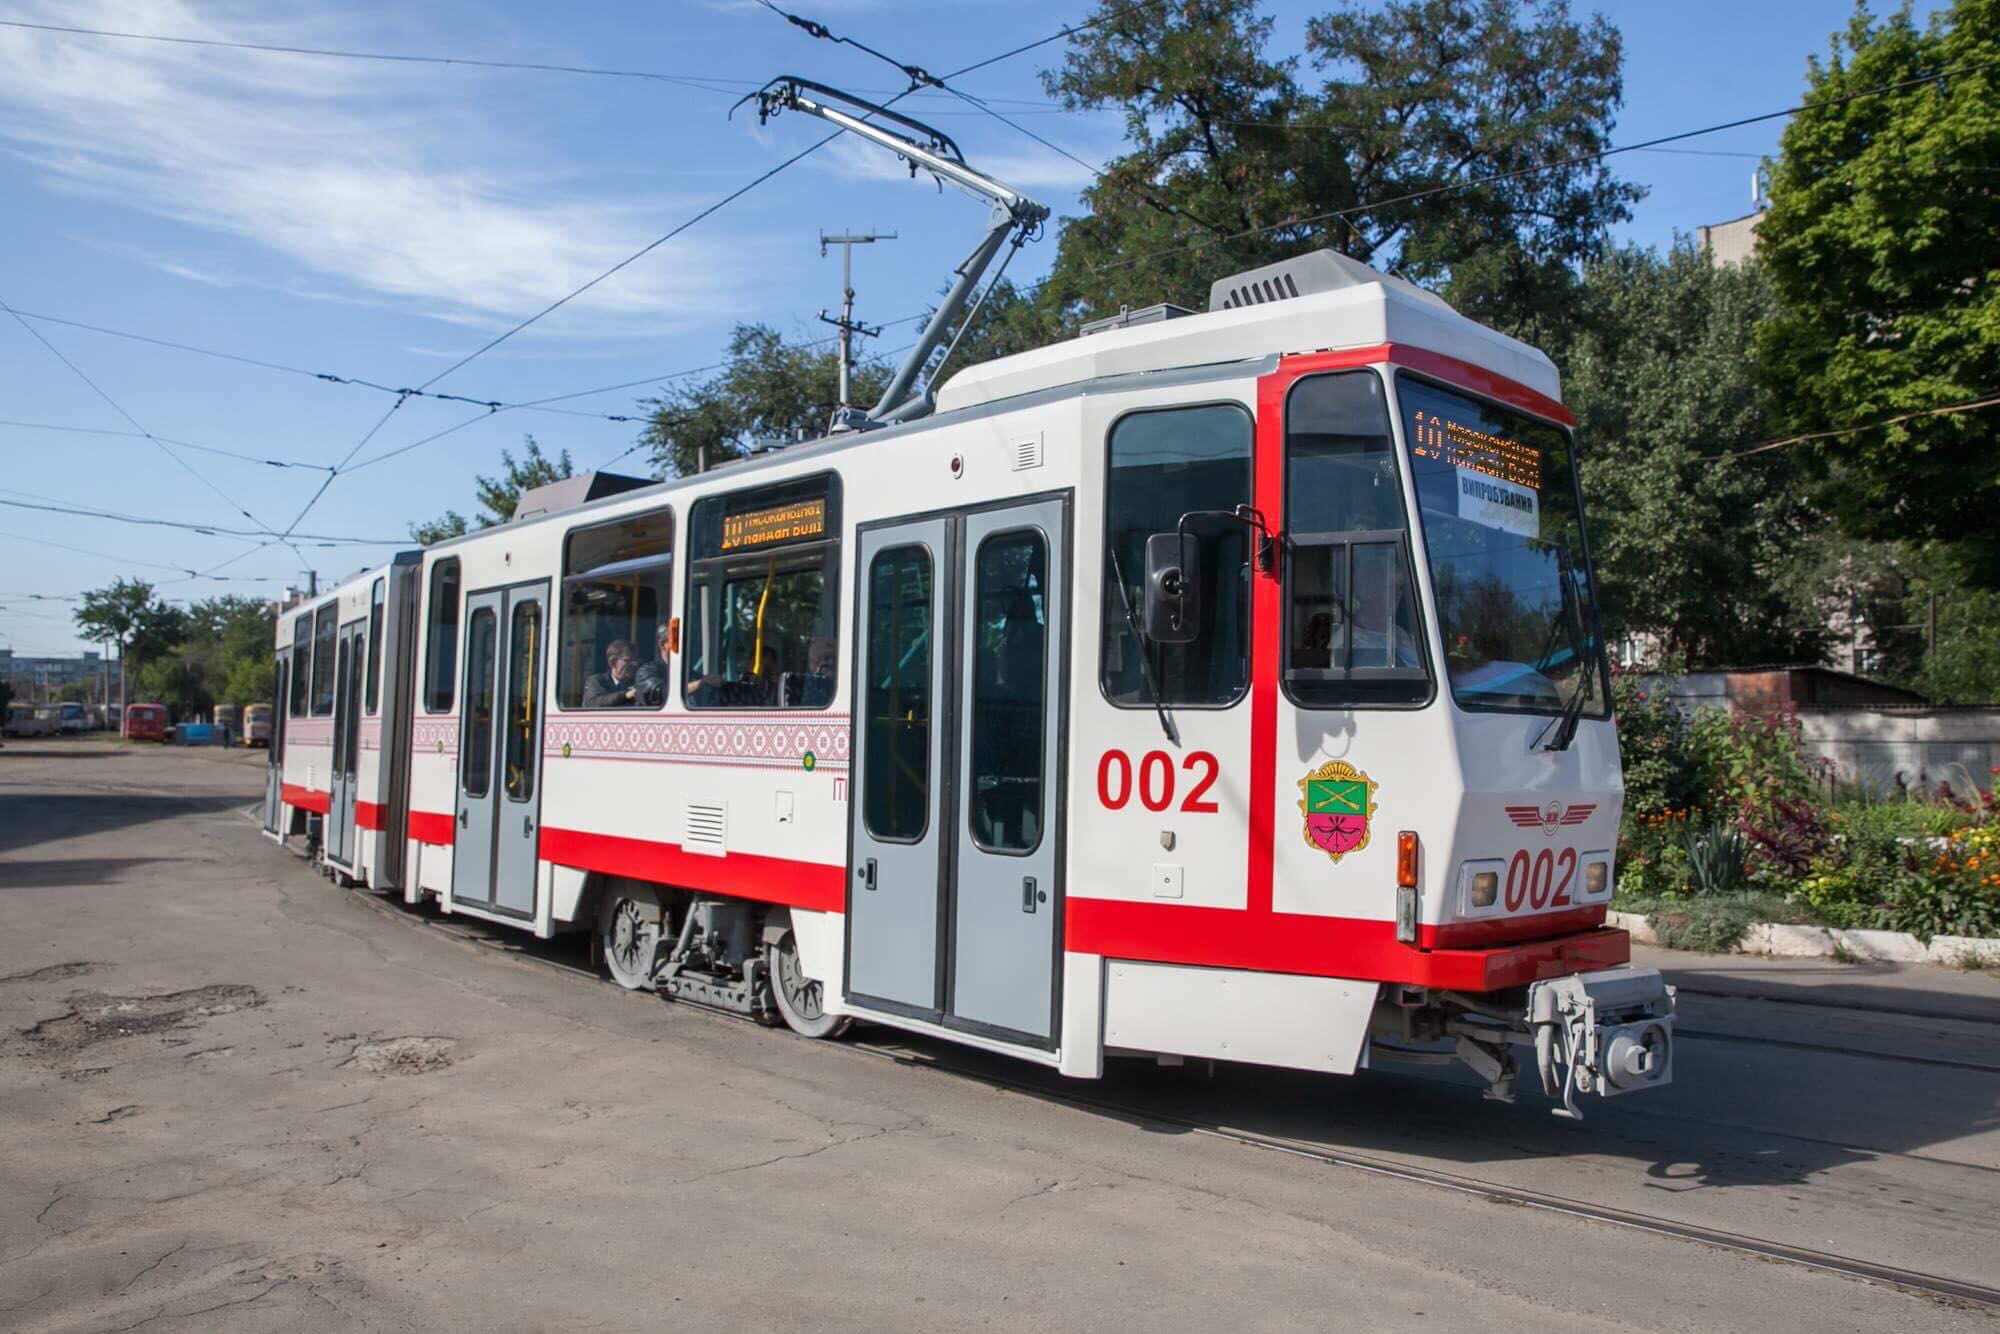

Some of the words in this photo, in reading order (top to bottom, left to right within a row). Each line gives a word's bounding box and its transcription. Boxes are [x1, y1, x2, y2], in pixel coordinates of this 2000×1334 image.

[1414, 410, 1442, 460] 10
[1461, 476, 1533, 514] ВИПРОБУВАННЯ
[721, 515, 744, 549] 10
[1097, 748, 1220, 814] 002
[1504, 846, 1577, 913] 002
